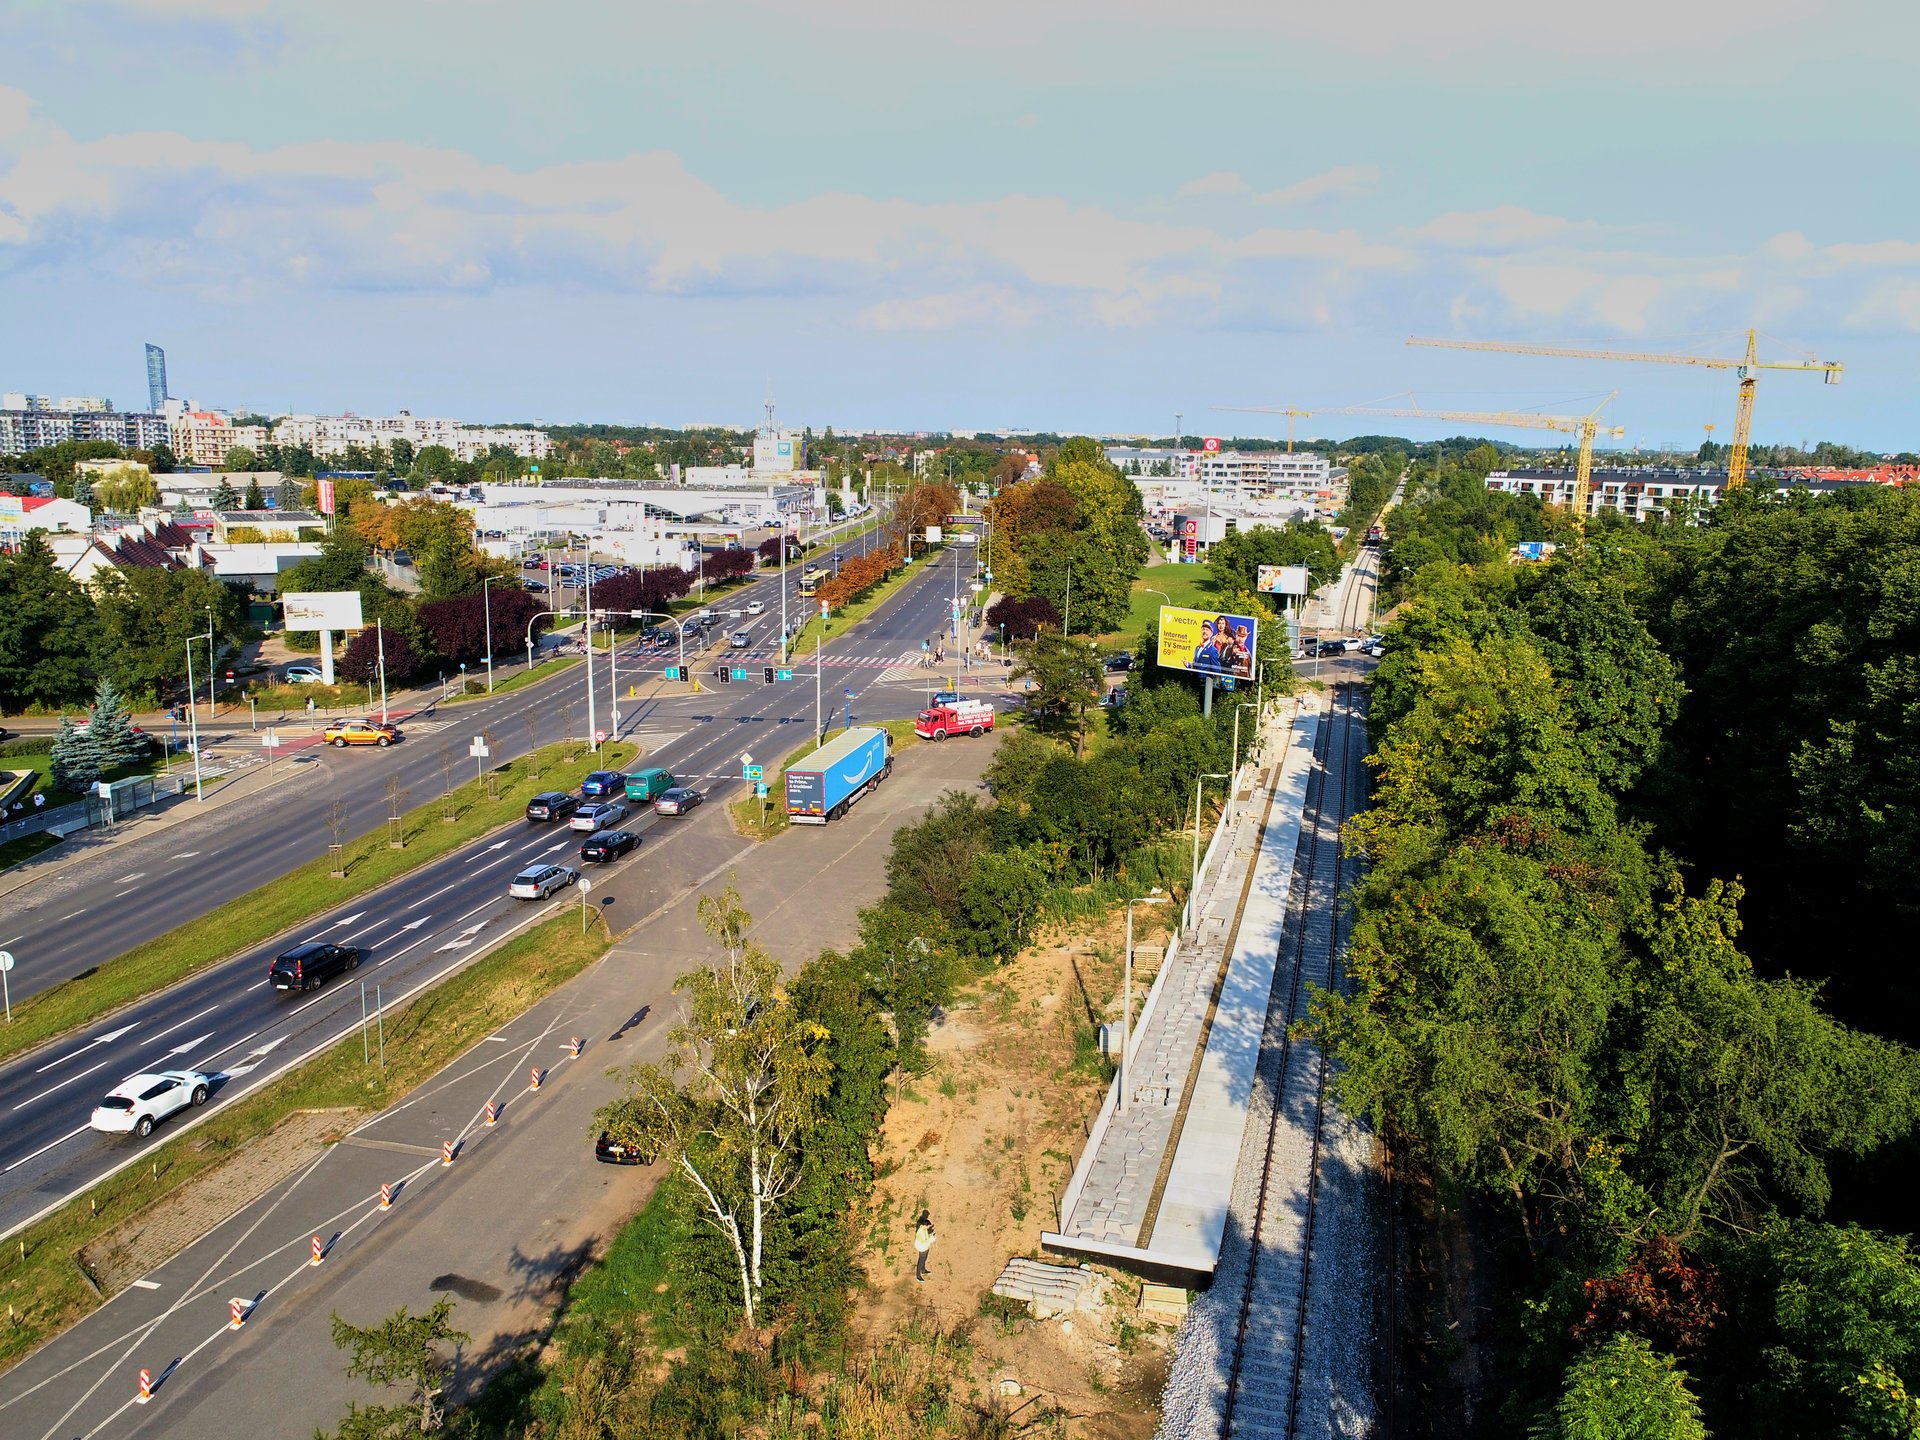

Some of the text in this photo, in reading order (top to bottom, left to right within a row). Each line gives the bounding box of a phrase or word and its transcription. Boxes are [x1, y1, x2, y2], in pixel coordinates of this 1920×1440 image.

[1174, 617, 1197, 625] vectra
[1164, 630, 1187, 639] Internet
[1173, 642, 1190, 651] Smart
